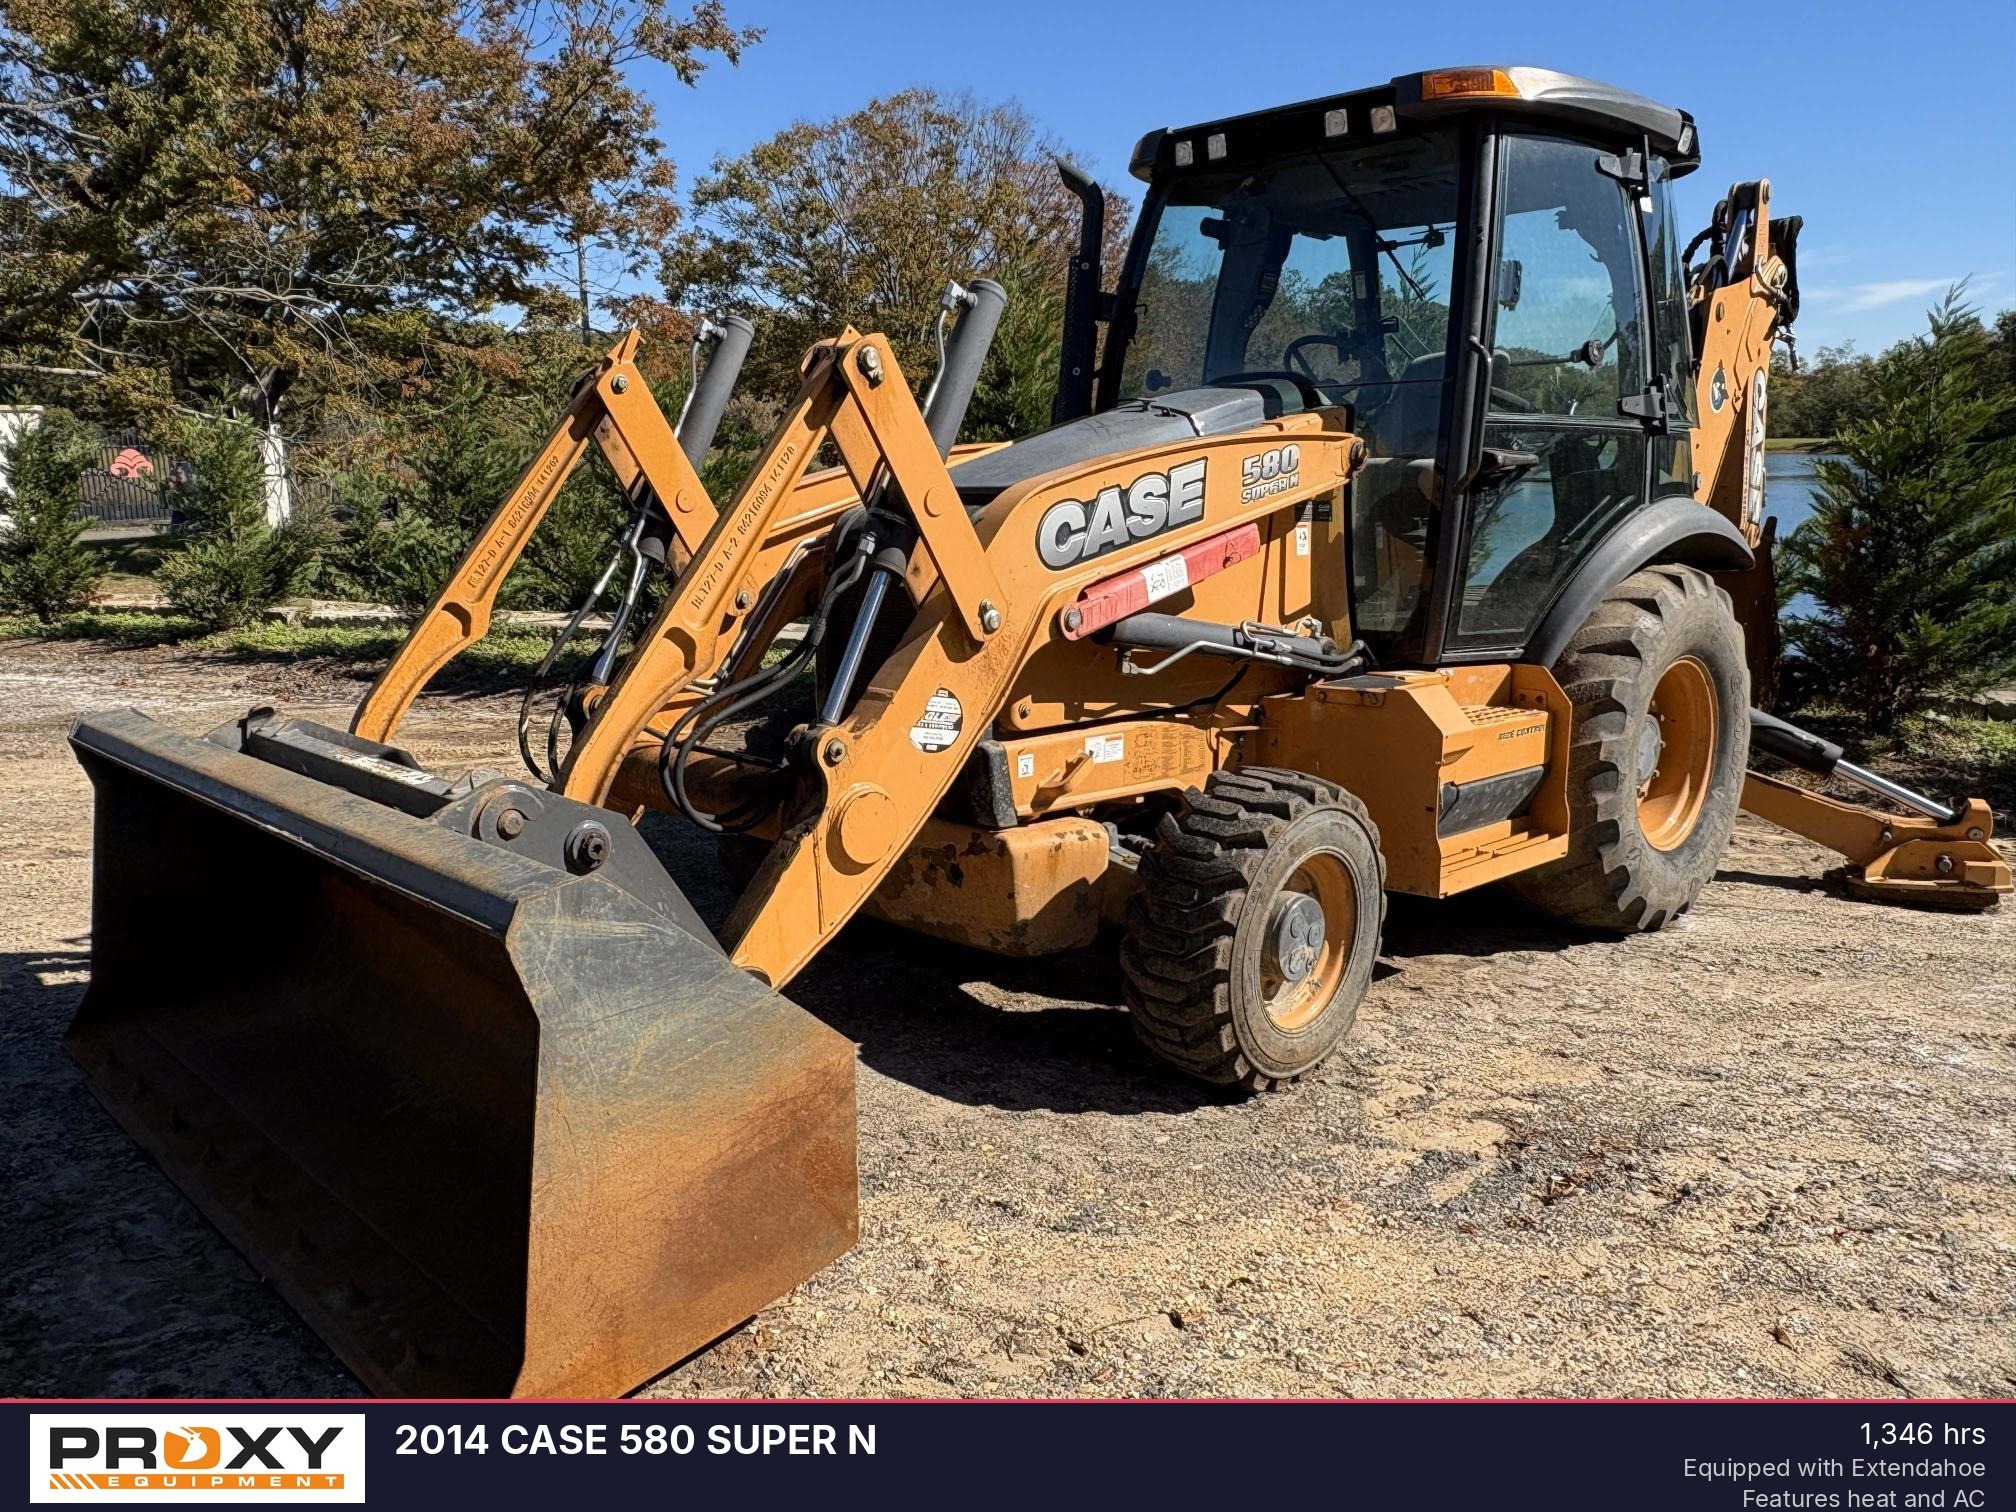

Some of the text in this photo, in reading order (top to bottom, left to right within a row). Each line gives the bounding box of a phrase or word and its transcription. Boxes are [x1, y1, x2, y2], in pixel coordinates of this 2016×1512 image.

[1242, 443, 1300, 488] 580
[1241, 472, 1299, 504] SUPER N
[1036, 457, 1207, 571] CASE
[726, 537, 741, 560] A-2
